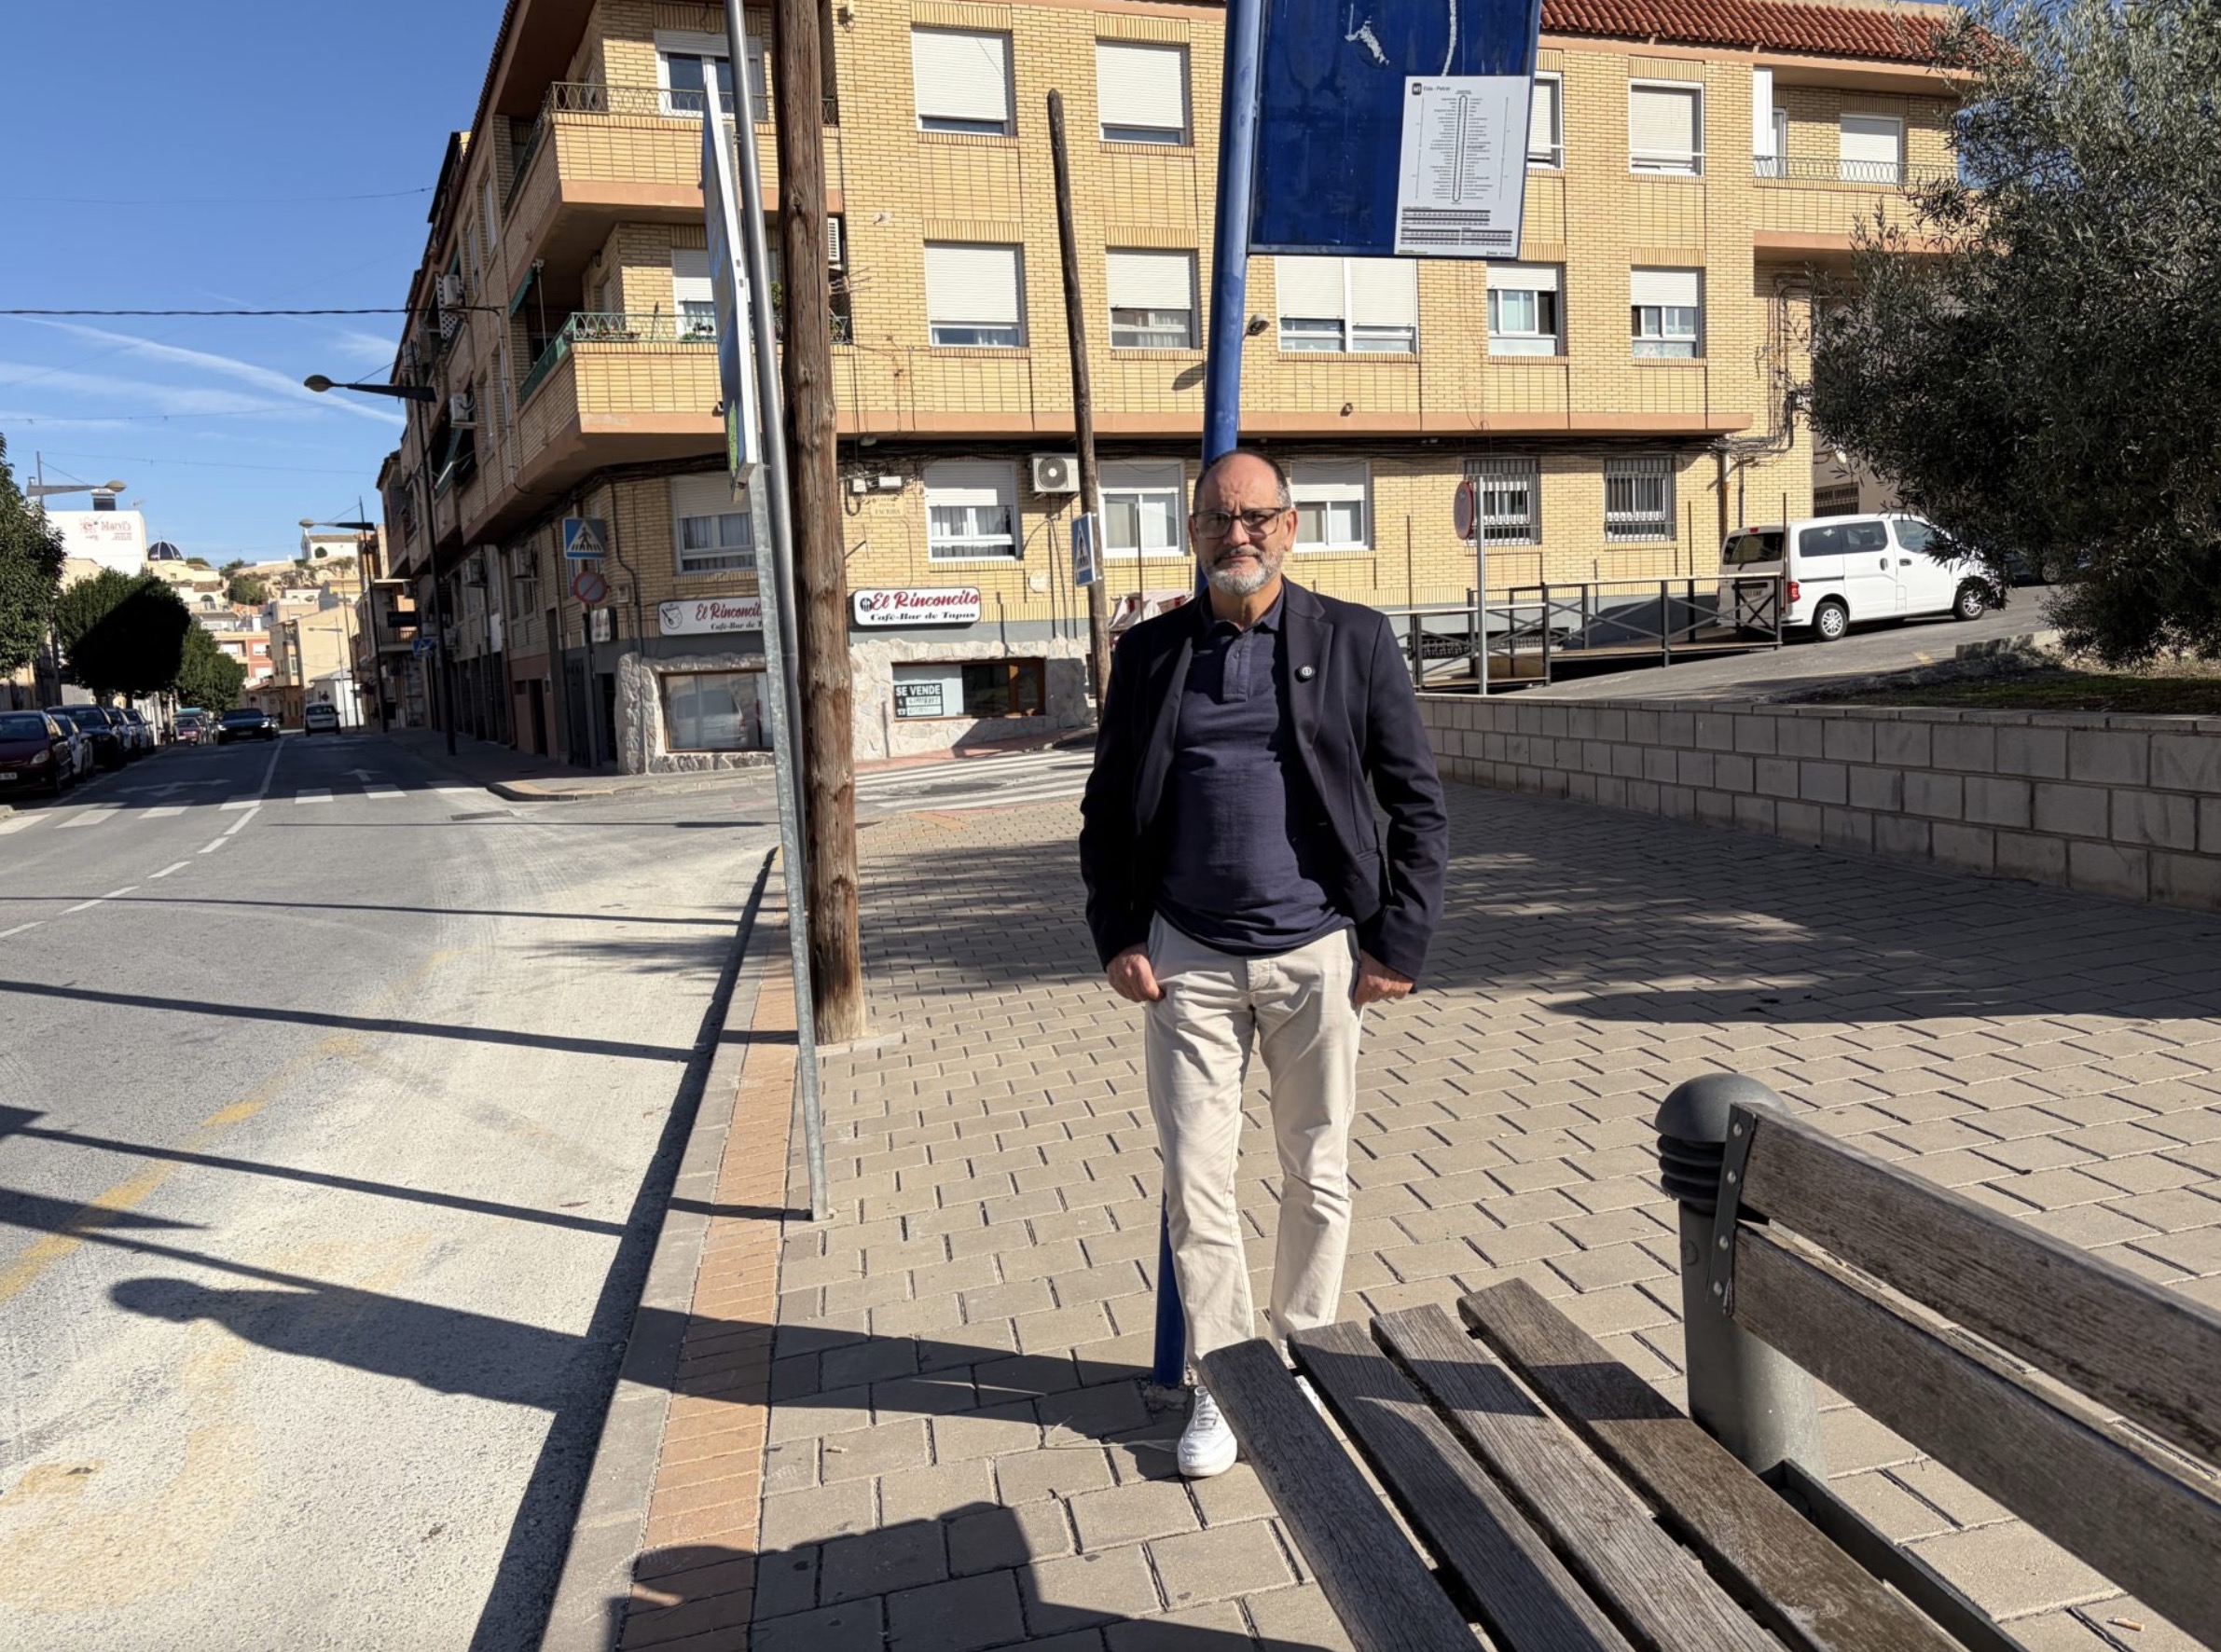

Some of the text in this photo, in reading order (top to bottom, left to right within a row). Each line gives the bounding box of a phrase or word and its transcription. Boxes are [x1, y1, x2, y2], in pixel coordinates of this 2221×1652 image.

[871, 589, 979, 611] El Rinconcito
[695, 601, 762, 622] El Rinconcit
[925, 612, 938, 620] de
[942, 611, 976, 620] Tapas
[895, 684, 941, 696] SE VENDE
